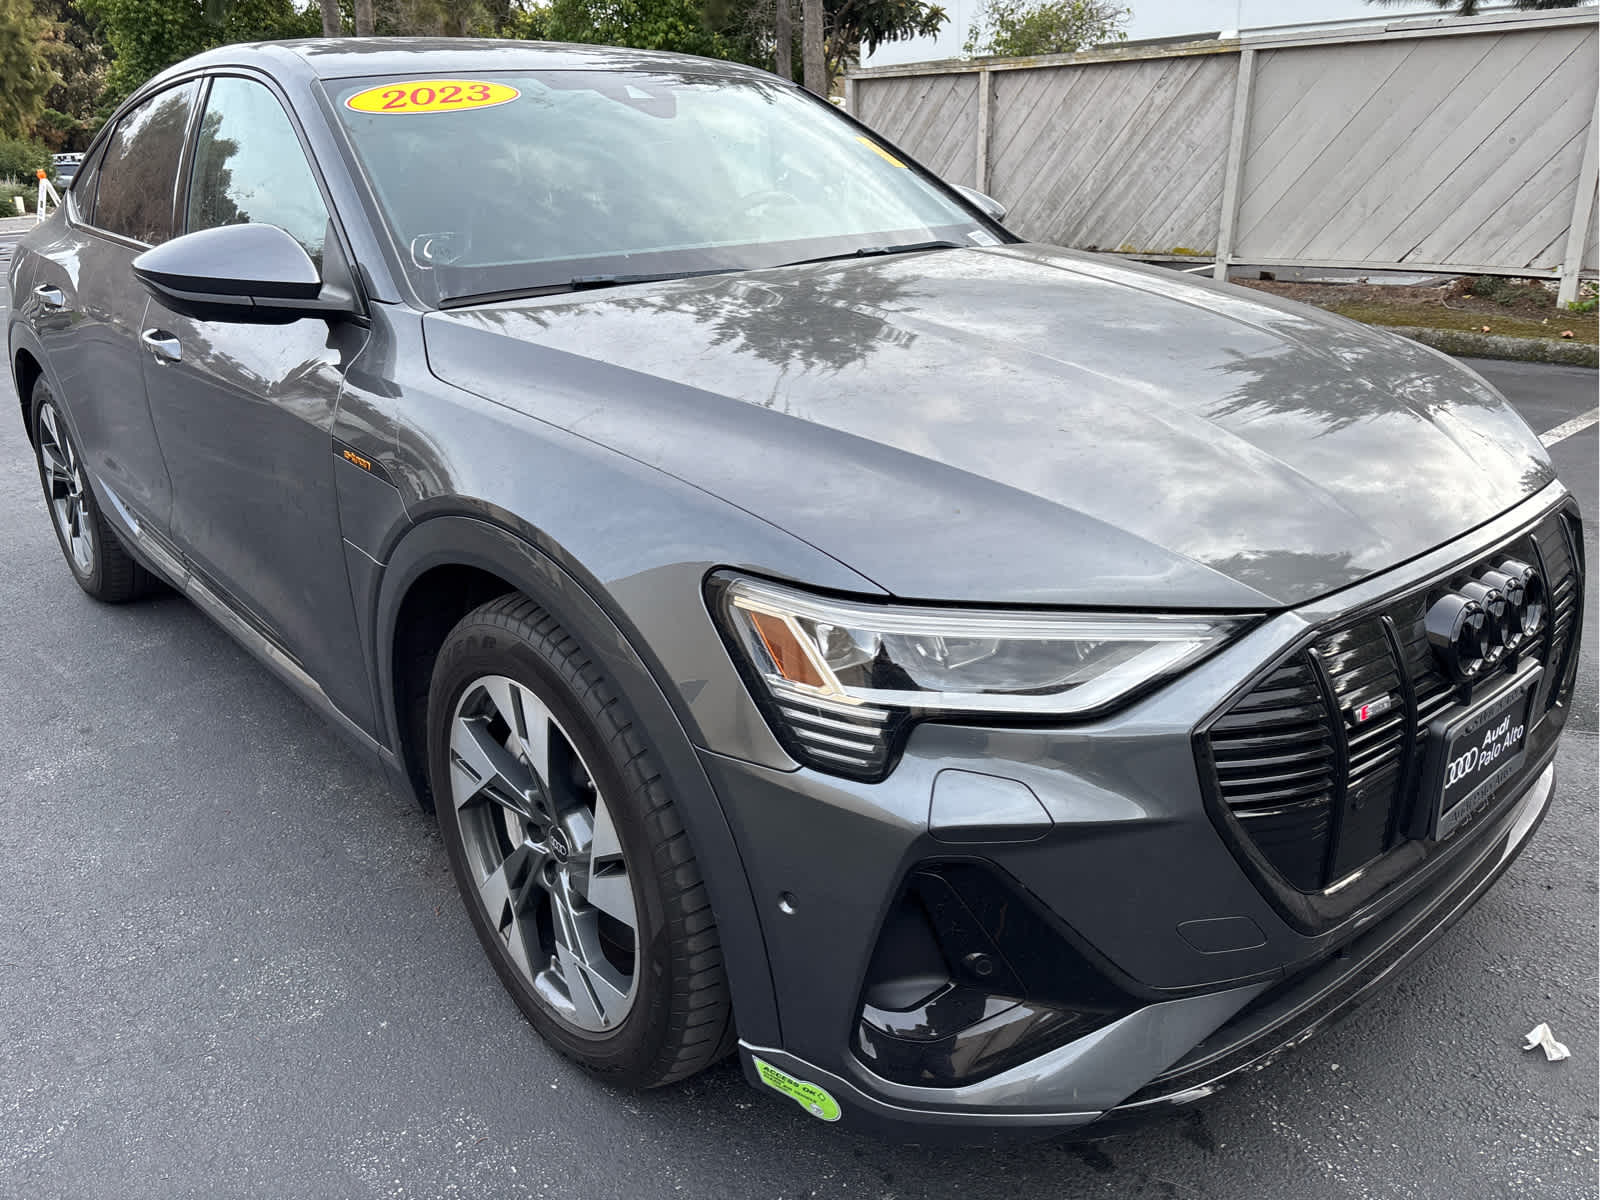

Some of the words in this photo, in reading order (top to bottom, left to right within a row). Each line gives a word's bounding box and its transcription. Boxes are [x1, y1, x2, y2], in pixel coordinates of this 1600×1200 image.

[381, 84, 492, 110] 2023
[1477, 742, 1501, 771] Palo
[1501, 724, 1525, 751] Alto
[1481, 714, 1512, 749] Audi
